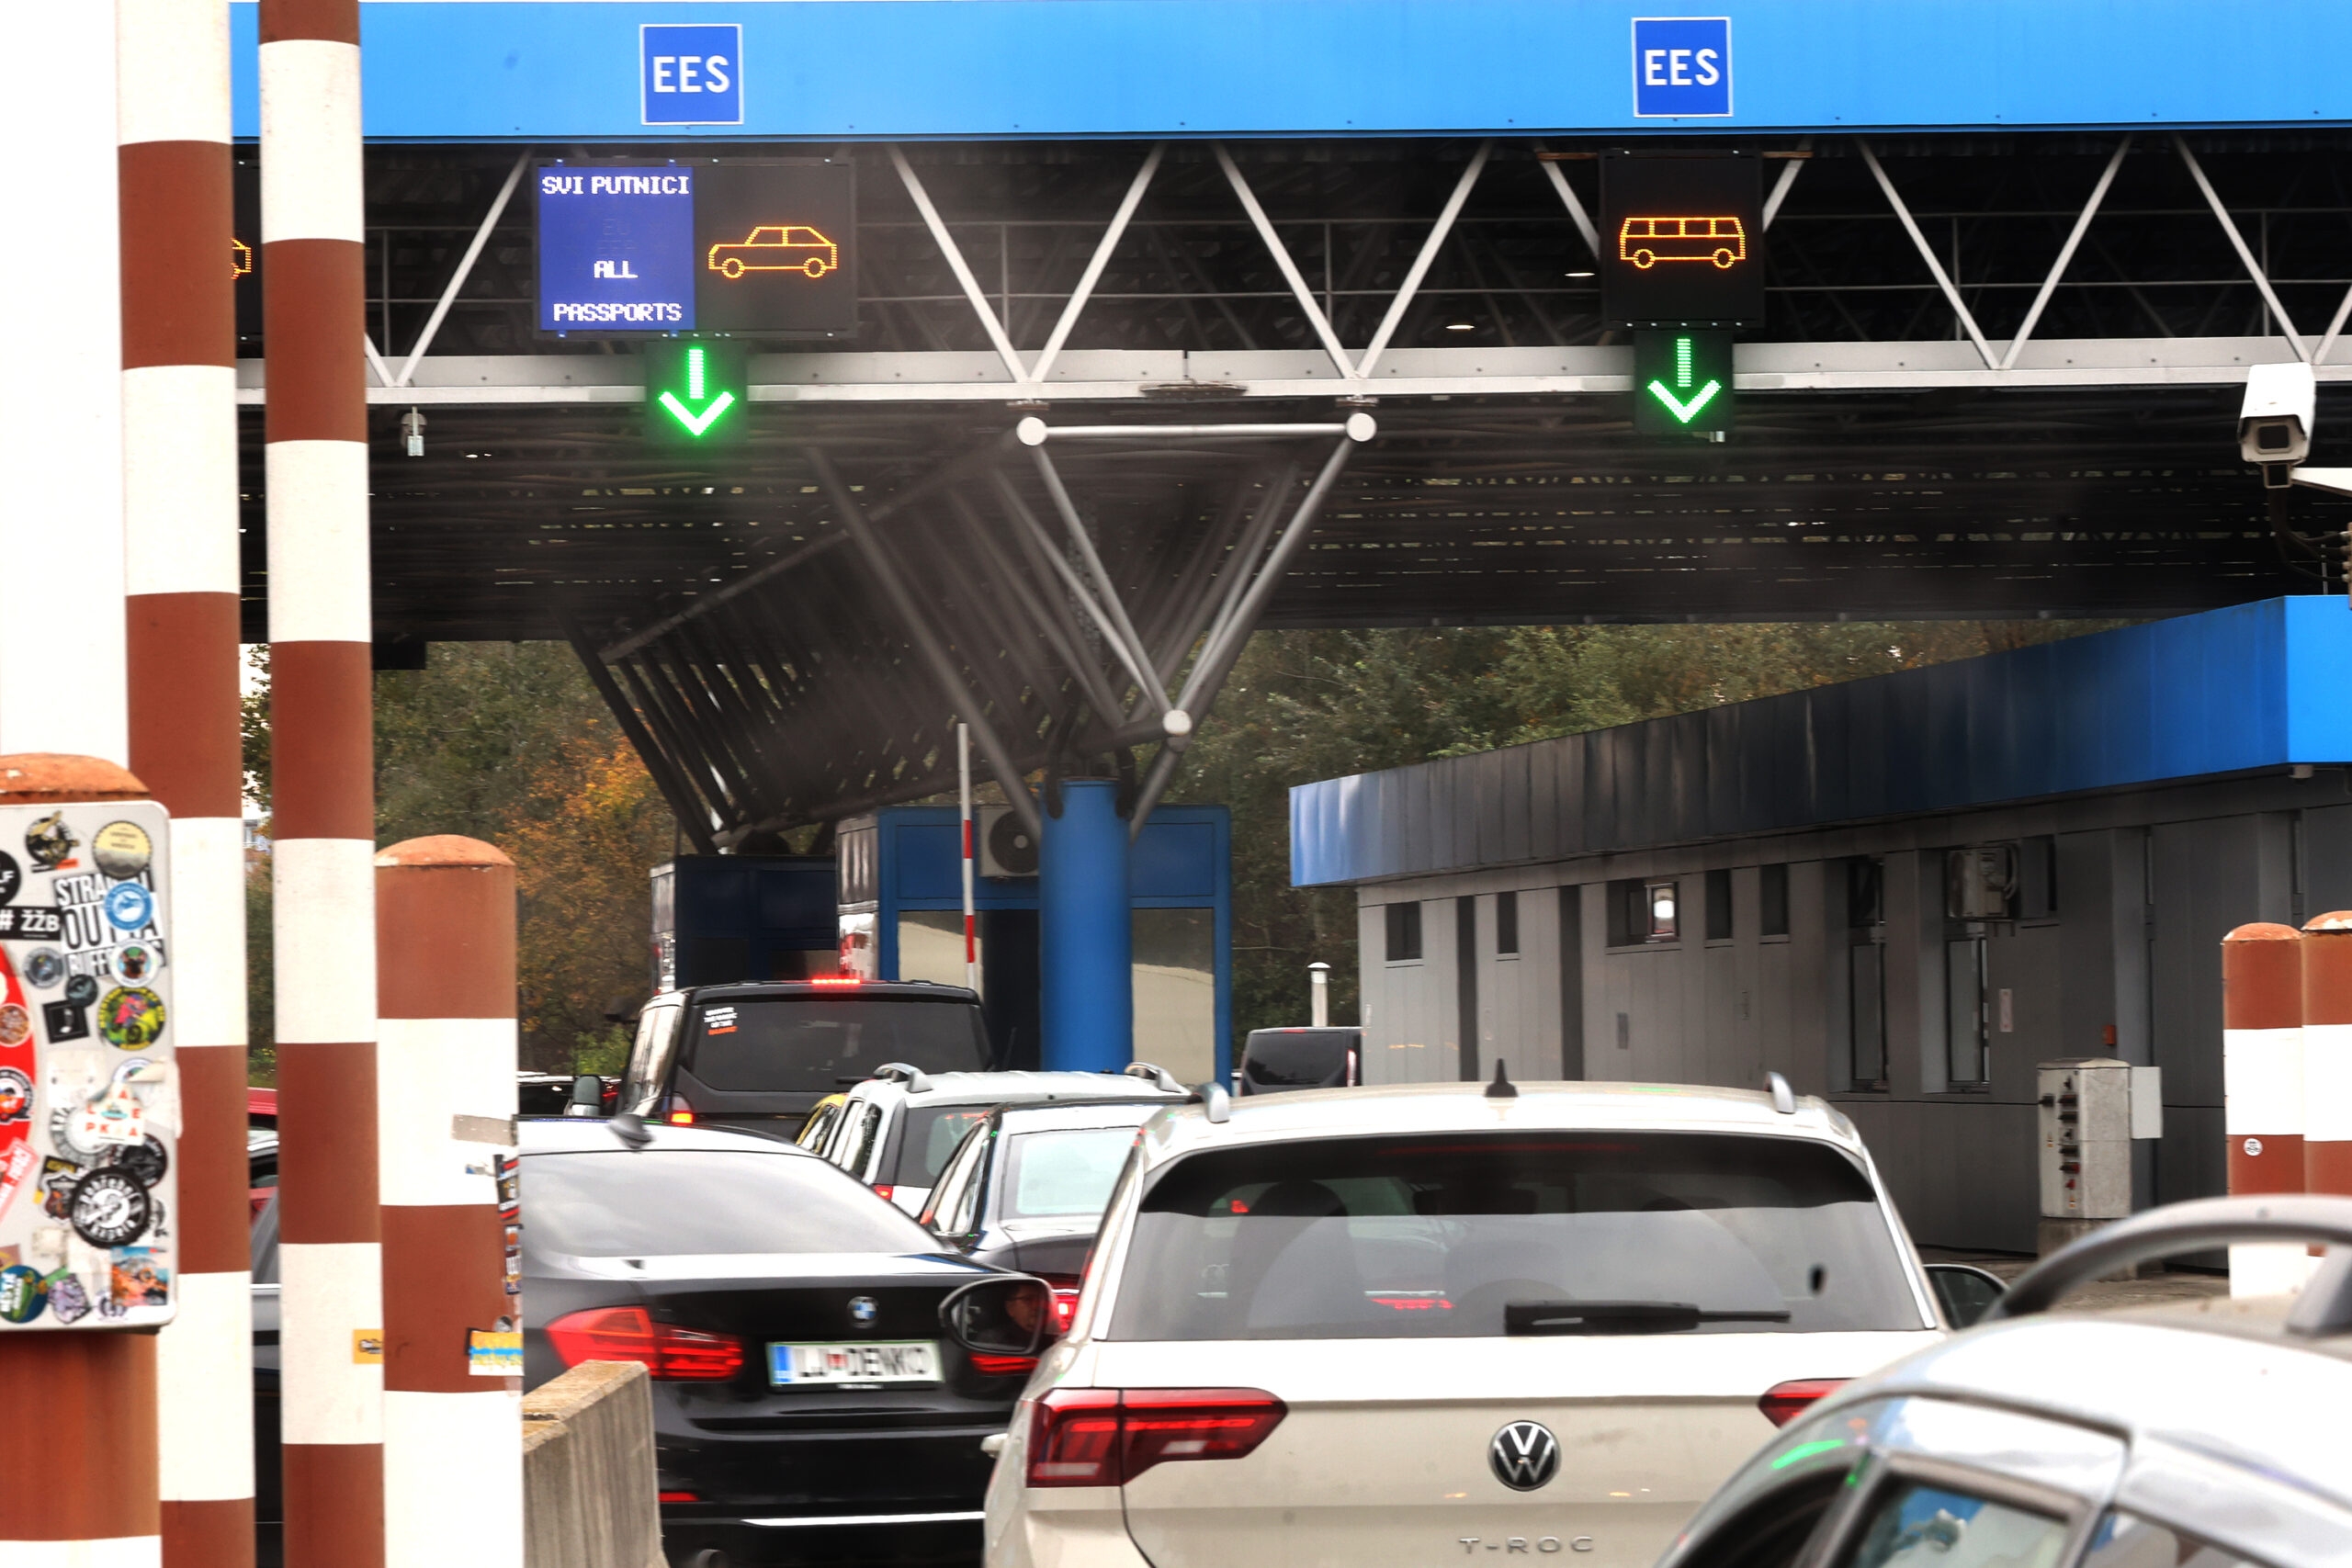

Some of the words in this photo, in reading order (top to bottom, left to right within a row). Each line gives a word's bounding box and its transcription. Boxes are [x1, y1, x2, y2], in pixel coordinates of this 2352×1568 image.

[653, 54, 730, 94] EES
[1645, 48, 1720, 86] EES
[541, 175, 584, 195] SVI
[591, 175, 690, 195] PUTNICI
[594, 260, 639, 278] ALL
[553, 302, 683, 321] PASSPORTS
[1458, 1536, 1594, 1554] T-ROC
